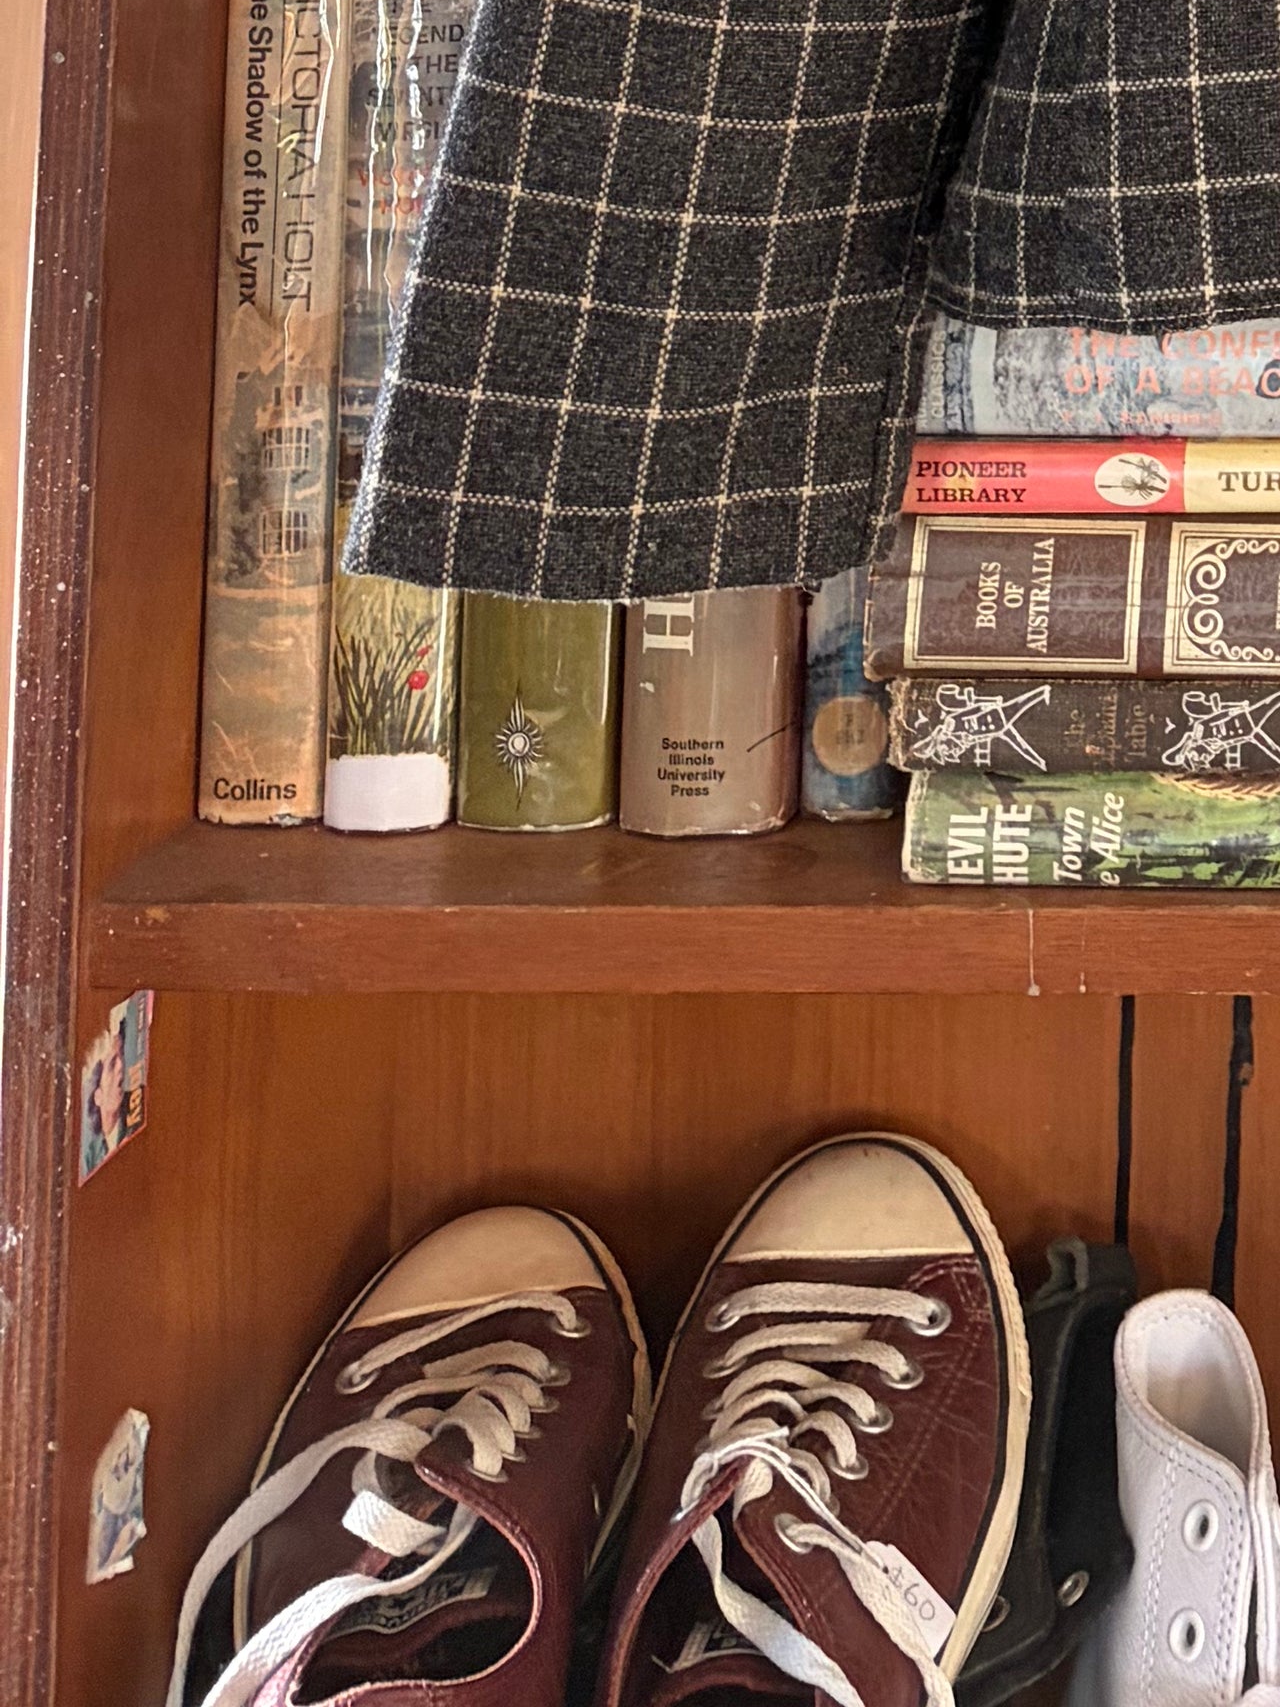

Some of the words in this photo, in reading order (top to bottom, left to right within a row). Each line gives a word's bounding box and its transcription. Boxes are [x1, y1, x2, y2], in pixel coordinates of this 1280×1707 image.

[243, 27, 274, 144] Shadow
[243, 149, 269, 179] of
[240, 186, 264, 236] the
[234, 240, 265, 309] Lynx
[281, 193, 315, 313] HOLT
[1067, 329, 1140, 360] THE
[930, 330, 947, 419] CLASSICS
[1063, 366, 1104, 396] OF
[1133, 366, 1163, 395] A
[915, 459, 1028, 480] PIONEER
[916, 487, 1027, 505] LIBRARY
[975, 561, 1002, 631] BOOKS
[1026, 537, 1056, 654] AUSTRALIA
[661, 738, 725, 751] Southern
[212, 776, 298, 802] Collins
[657, 768, 726, 784] University
[1053, 805, 1087, 883] Town
[1090, 791, 1126, 864] Alice
